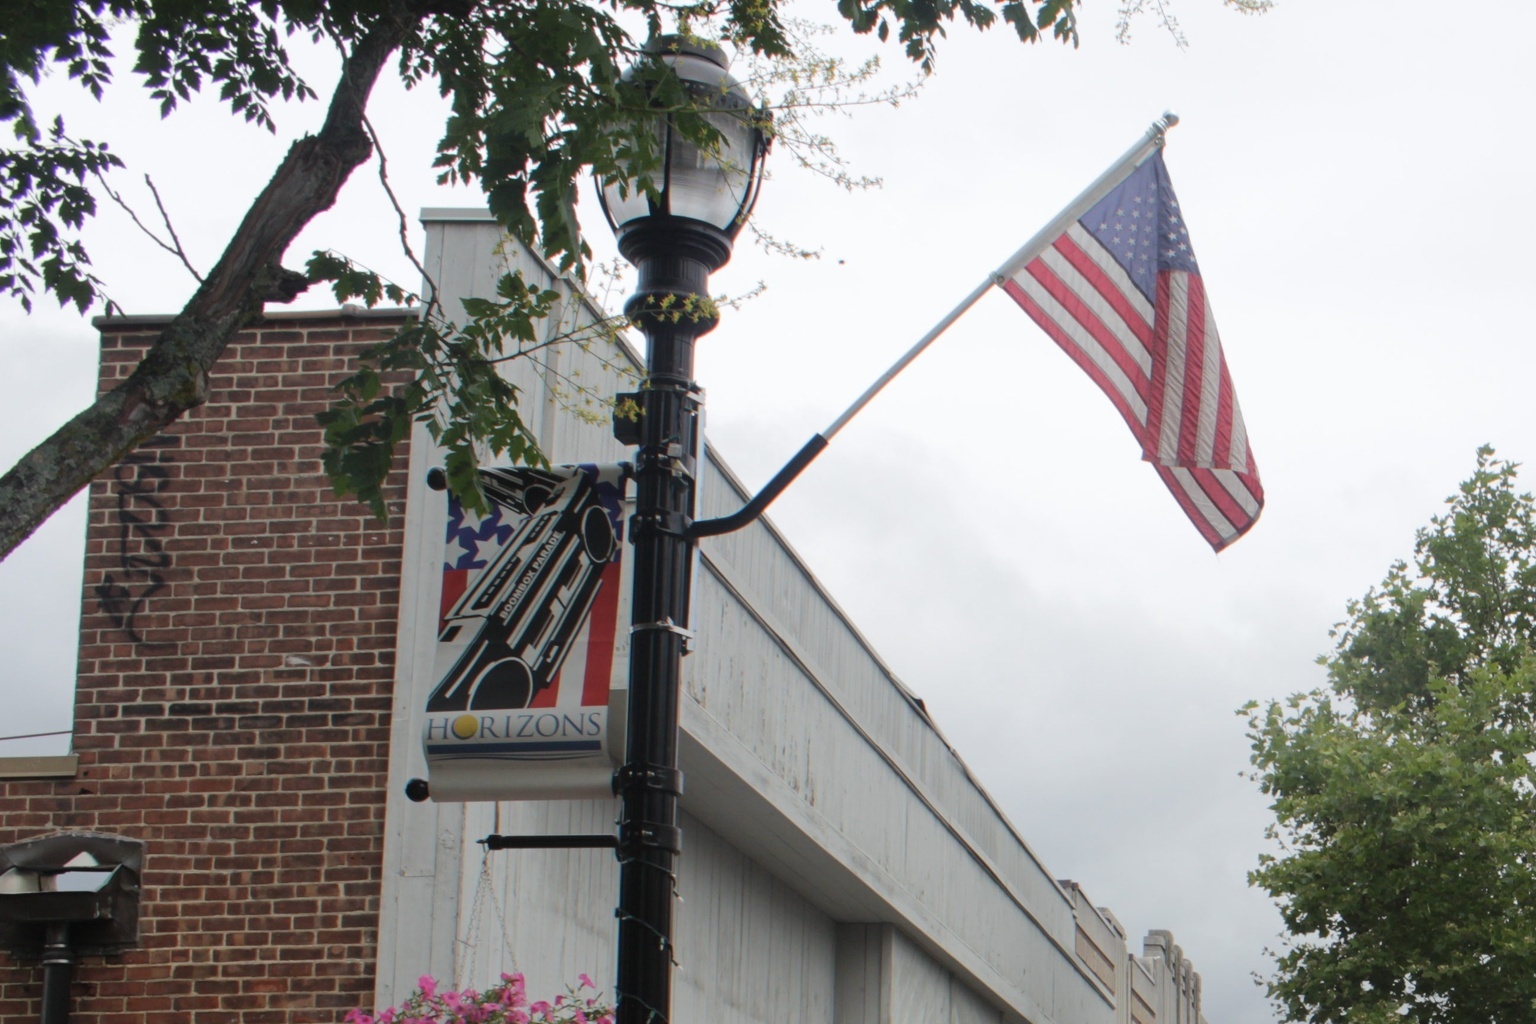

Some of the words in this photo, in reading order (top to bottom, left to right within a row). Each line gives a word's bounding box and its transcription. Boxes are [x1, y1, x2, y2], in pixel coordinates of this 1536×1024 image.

[499, 570, 535, 619] BOOMBOX
[532, 530, 562, 570] PARADE
[426, 713, 601, 740] HORIZONS
